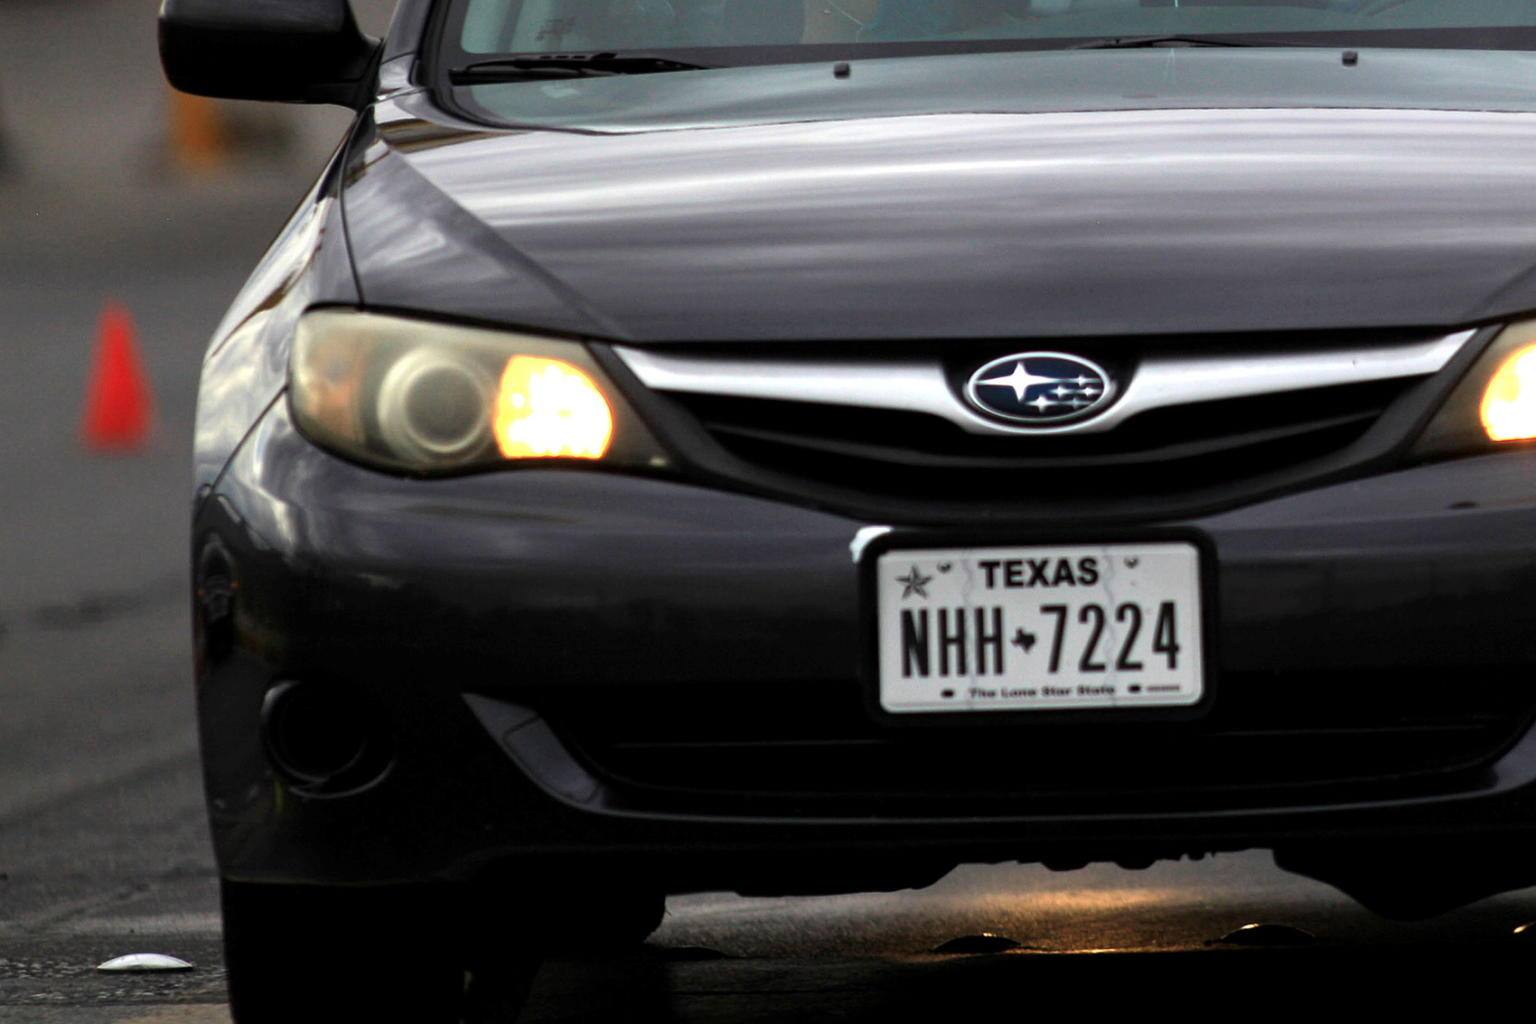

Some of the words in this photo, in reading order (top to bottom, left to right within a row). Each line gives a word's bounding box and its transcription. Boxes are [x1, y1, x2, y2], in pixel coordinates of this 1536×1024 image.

[979, 556, 1099, 589] TEXAS
[900, 606, 1004, 678] NHH
[1039, 600, 1180, 674] 7224
[968, 687, 996, 699] The
[1001, 686, 1037, 698] Lone
[1041, 685, 1071, 697] Star
[1077, 683, 1116, 696] State
